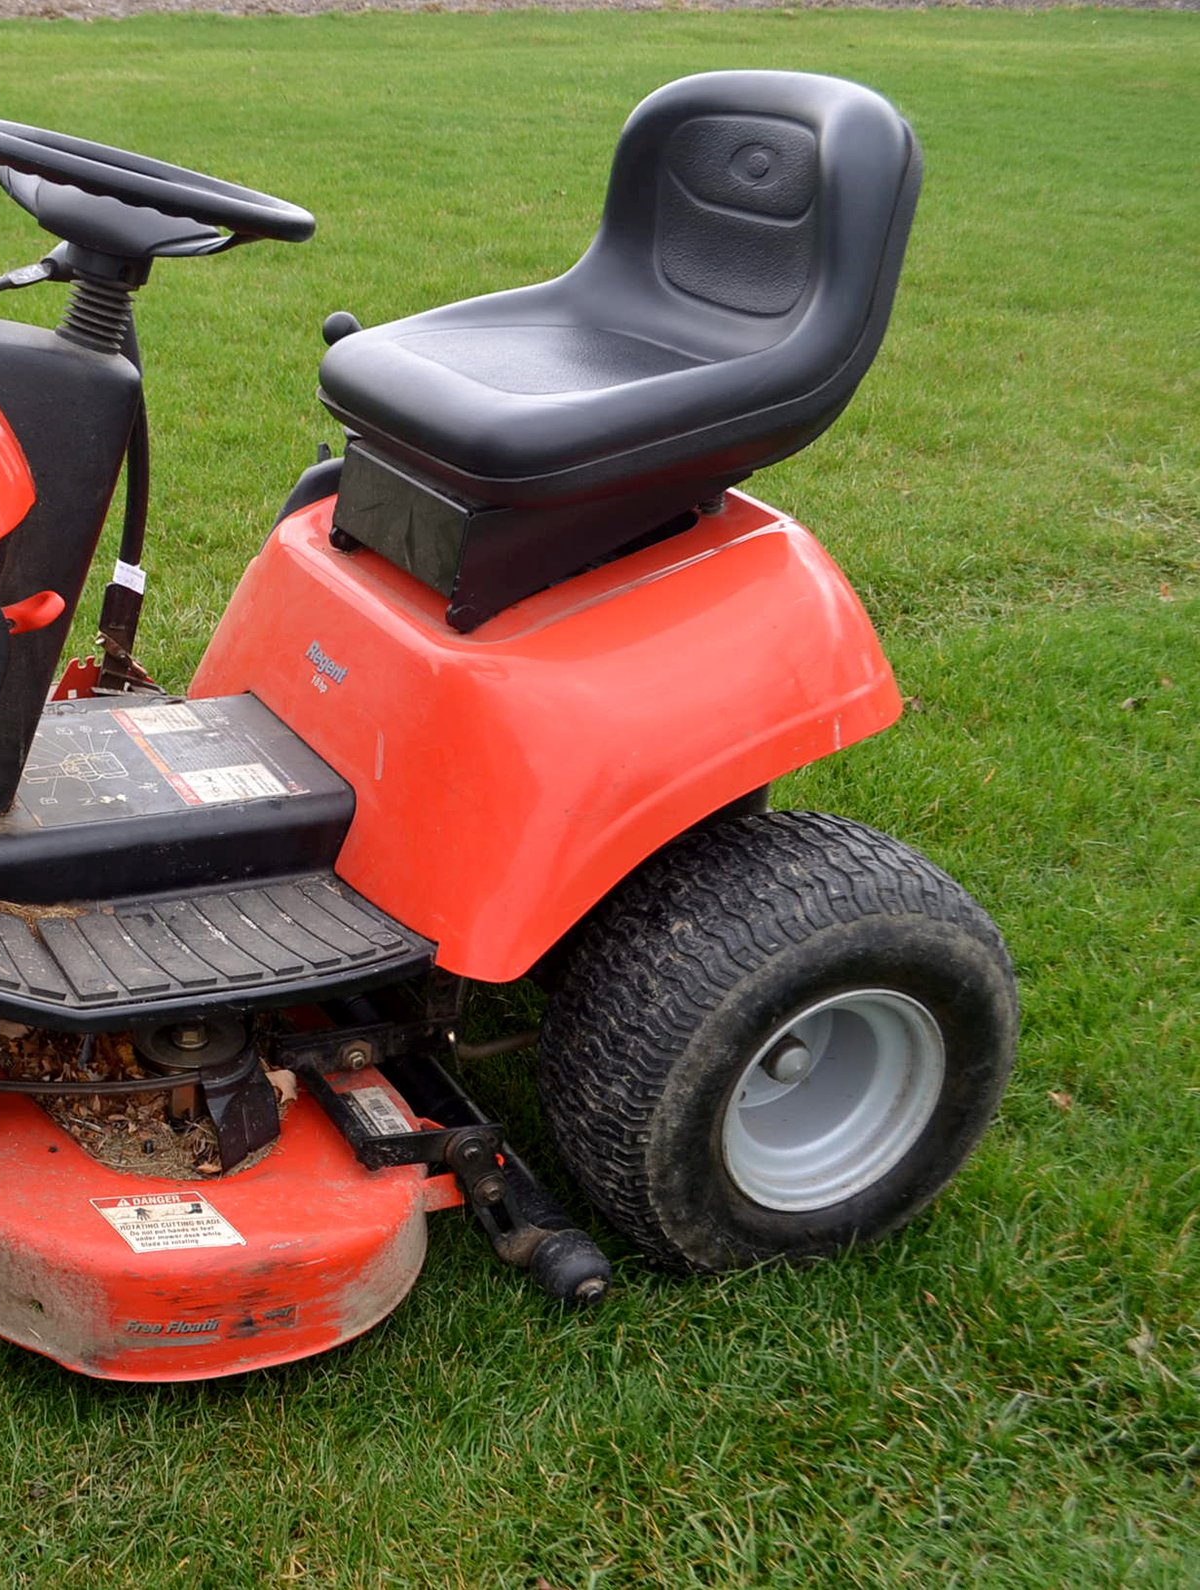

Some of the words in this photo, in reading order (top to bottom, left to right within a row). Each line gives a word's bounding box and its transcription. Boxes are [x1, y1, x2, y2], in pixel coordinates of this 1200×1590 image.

[305, 640, 348, 684] Regent
[132, 1195, 181, 1206] DANGER
[120, 1223, 159, 1231] ROTATING
[161, 1220, 194, 1228] CUTTING
[125, 1320, 163, 1333] Free
